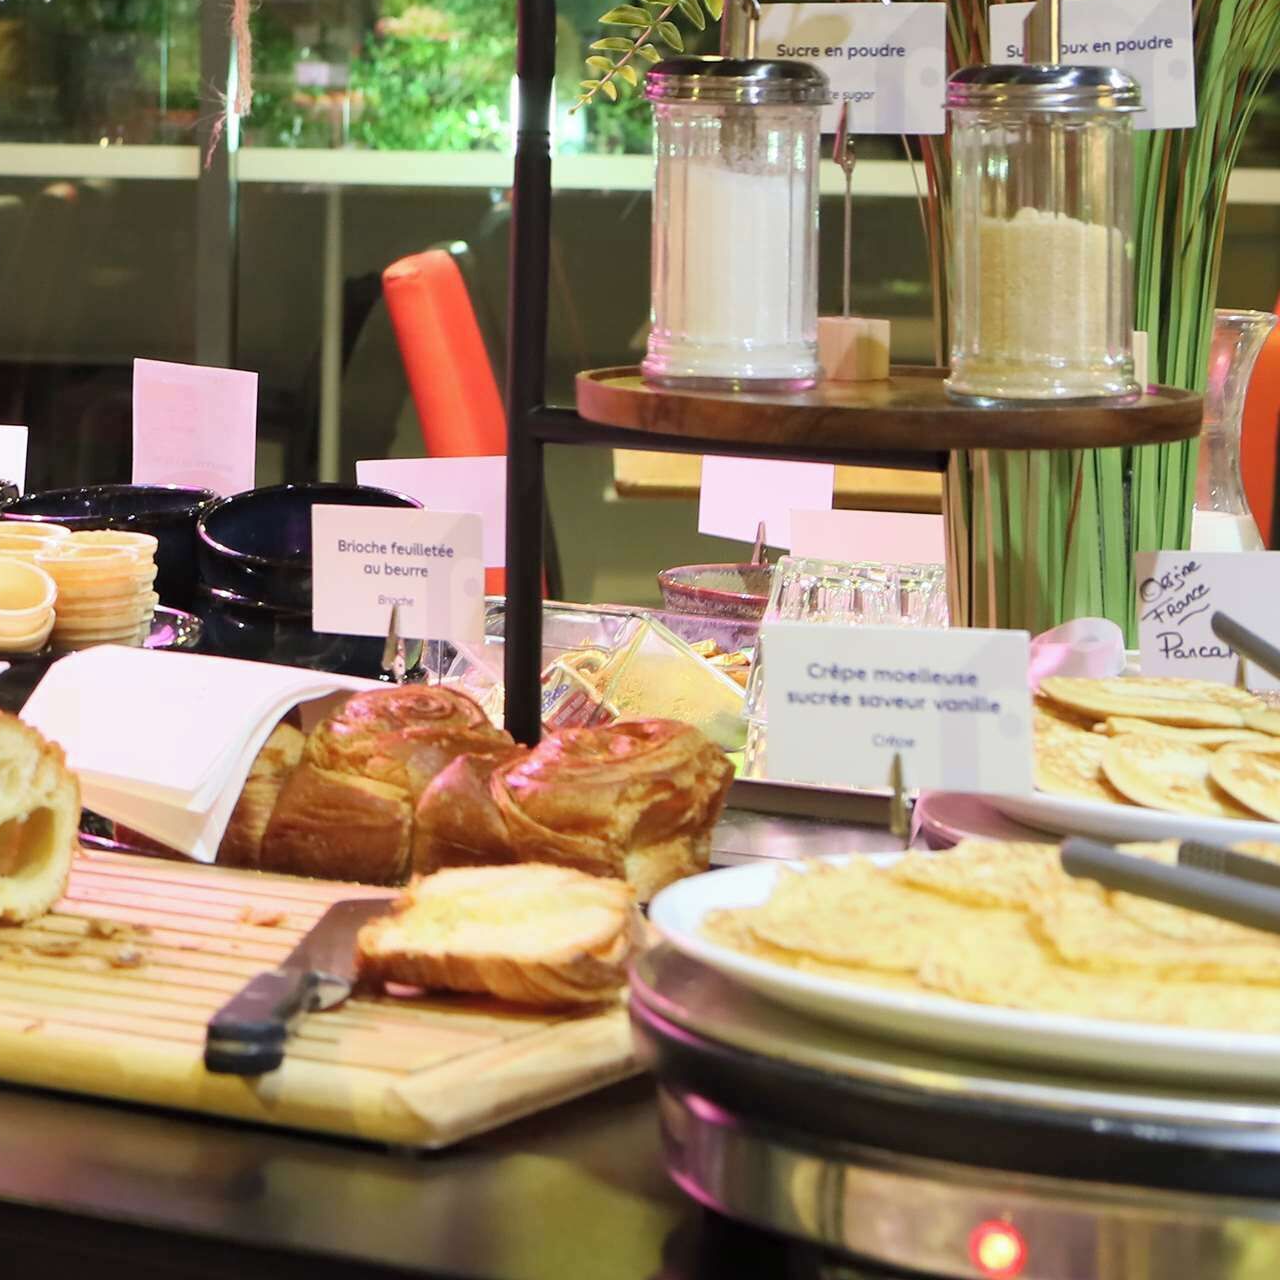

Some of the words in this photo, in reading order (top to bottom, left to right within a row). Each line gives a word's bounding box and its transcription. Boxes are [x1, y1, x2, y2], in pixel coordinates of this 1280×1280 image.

[776, 43, 820, 58] Sucre
[824, 45, 843, 58] en
[847, 43, 906, 61] poudre
[1092, 41, 1111, 53] en
[1115, 35, 1174, 55] poudre
[842, 91, 875, 103] sugar
[338, 539, 388, 554] Brioche
[390, 541, 454, 558] feuilletée
[363, 563, 380, 576] au
[384, 563, 429, 577] beurre
[377, 594, 415, 607] Brioche
[806, 661, 867, 683] Crêpe
[872, 666, 979, 687] moelleuse
[786, 687, 852, 707] sucrée
[858, 693, 926, 709] saveur
[932, 694, 1002, 715] vanille
[871, 732, 916, 749] Crêpe
